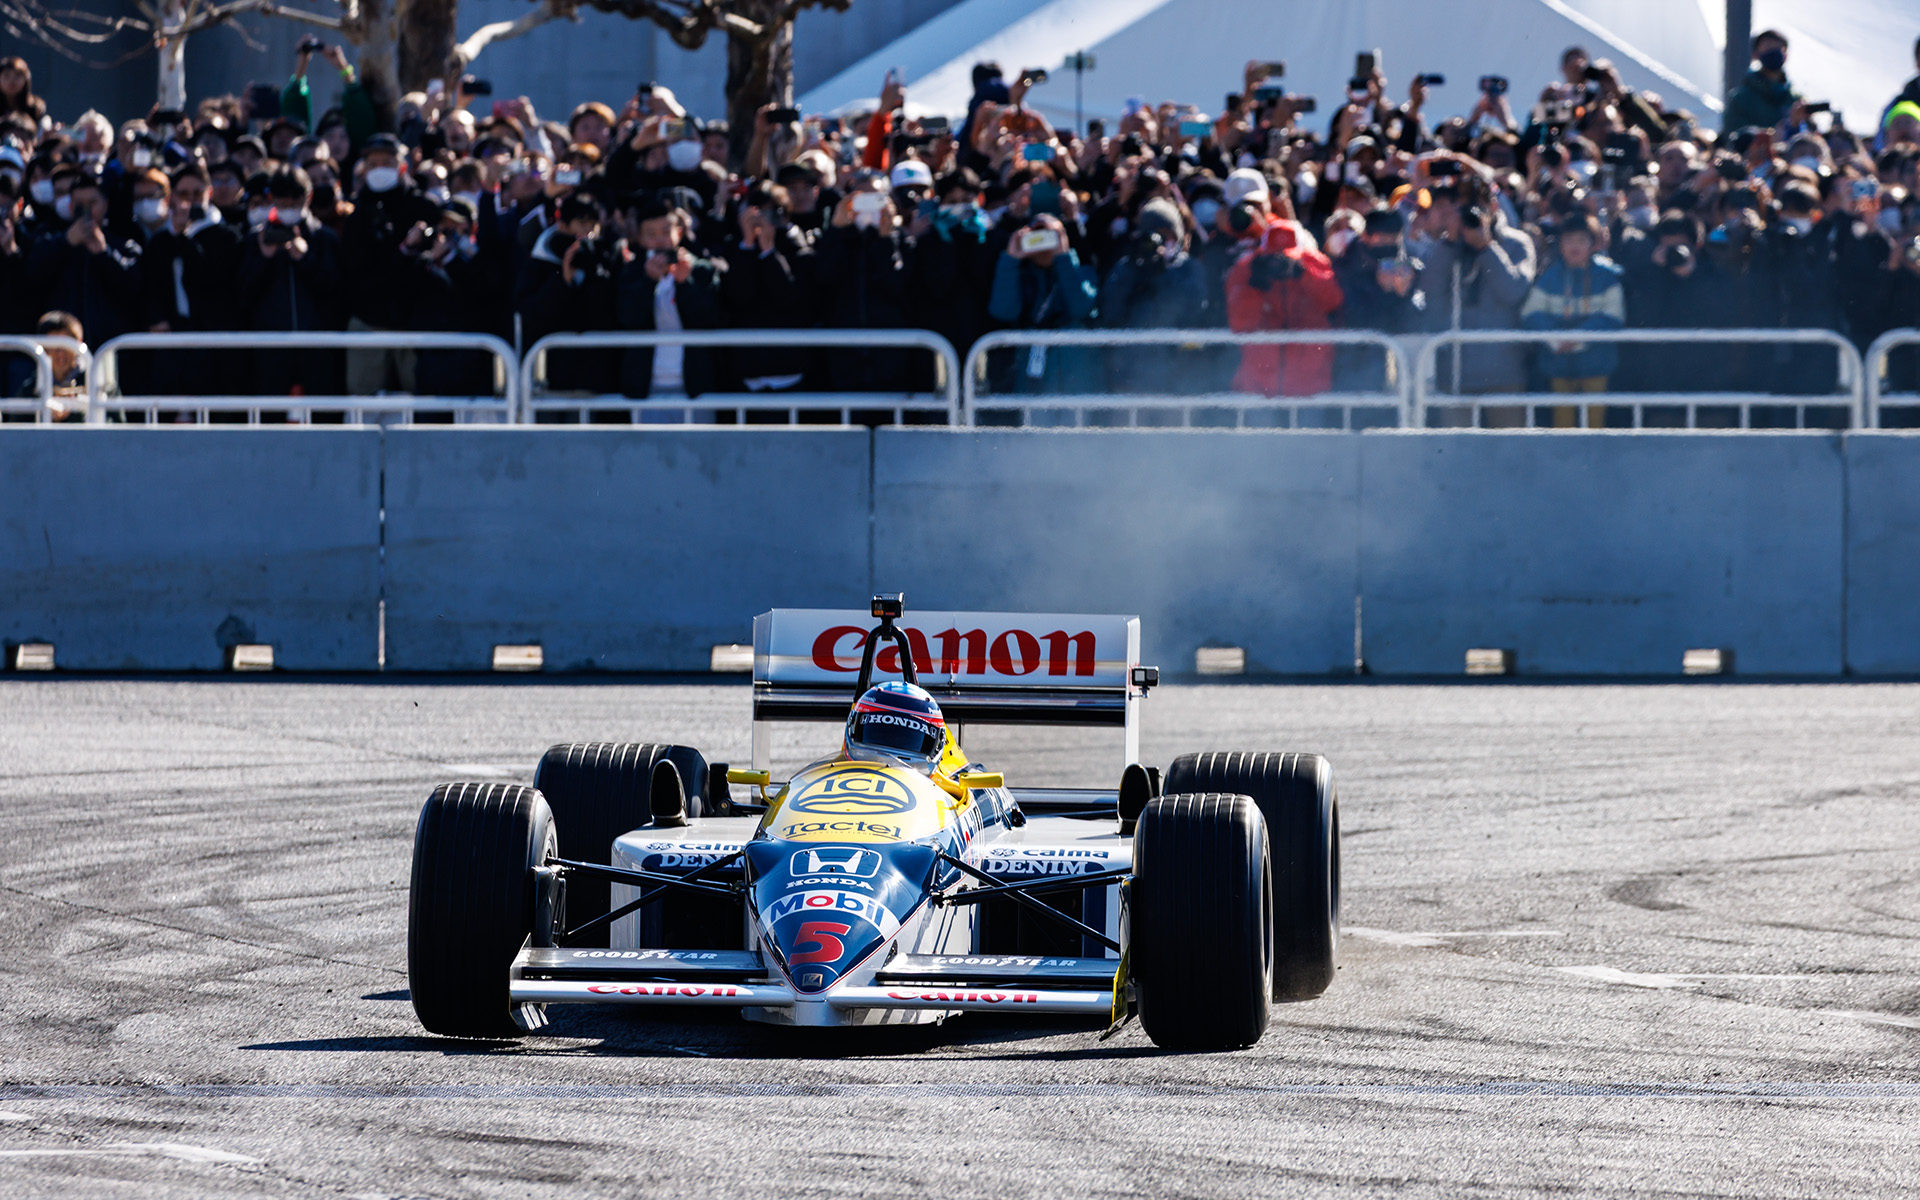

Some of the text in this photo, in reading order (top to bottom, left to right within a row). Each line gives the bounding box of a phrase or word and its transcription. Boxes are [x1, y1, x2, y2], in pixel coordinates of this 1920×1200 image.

[811, 625, 1096, 677] Canon
[869, 714, 931, 736] HONDA
[823, 778, 886, 793] ICI
[782, 820, 902, 839] Tactel
[679, 843, 745, 851] calm
[986, 859, 1088, 875] DENIM
[785, 877, 874, 891] HONDA
[770, 892, 885, 928] Mobil
[789, 921, 852, 967] 5
[572, 949, 718, 961] GOODYEAR
[932, 955, 1077, 967] GOODYEAR
[586, 984, 738, 998] Canon
[887, 990, 1038, 1004] Canon
